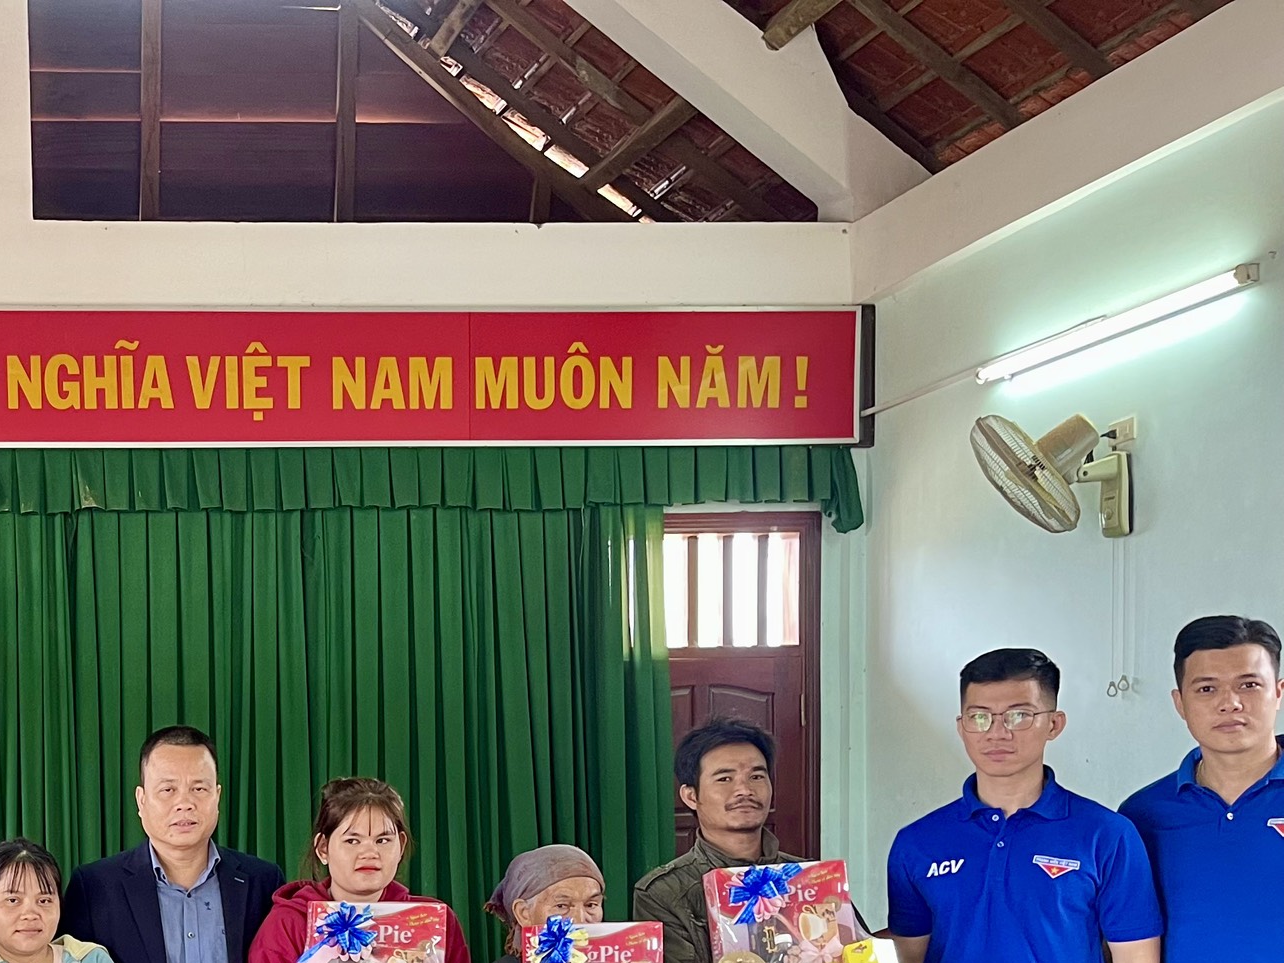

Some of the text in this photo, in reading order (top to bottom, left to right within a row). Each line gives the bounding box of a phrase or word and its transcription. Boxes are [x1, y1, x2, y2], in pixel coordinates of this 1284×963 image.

[6, 339, 174, 410] NGHĨA
[186, 342, 311, 421] VIỆT
[332, 356, 453, 410] NAM
[475, 341, 633, 410] MUÔN
[926, 858, 965, 878] ACV
